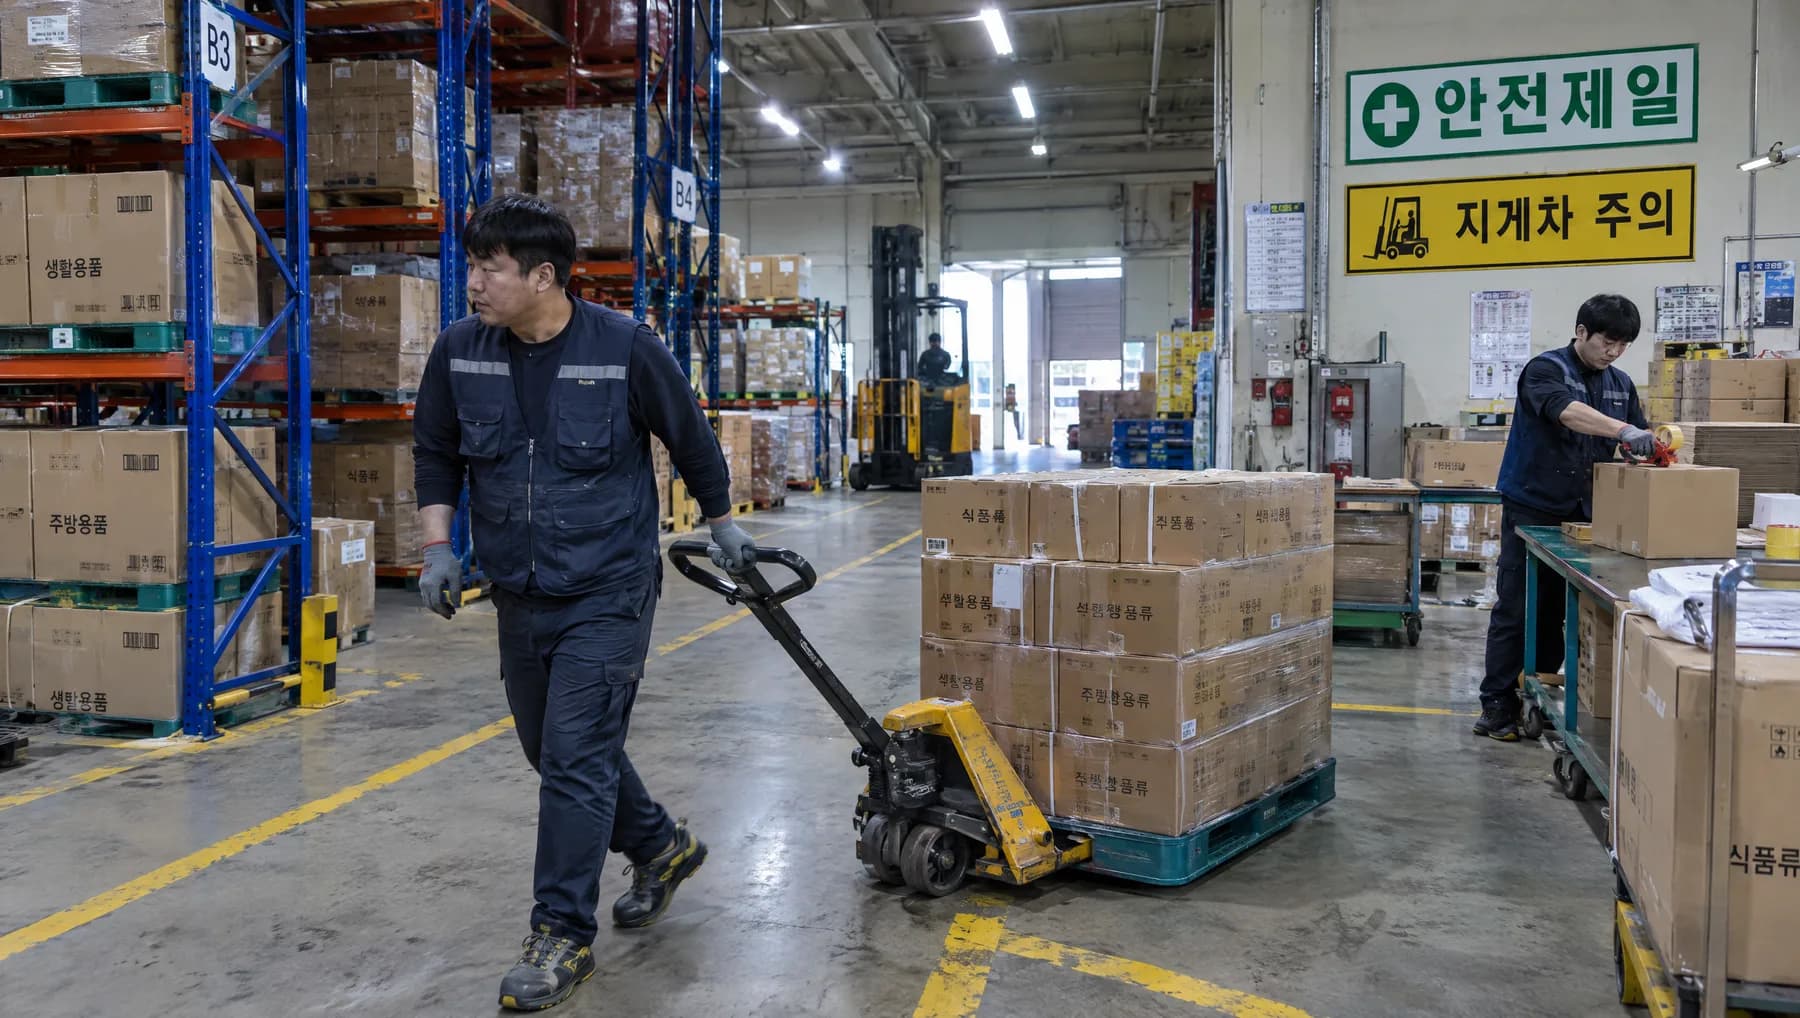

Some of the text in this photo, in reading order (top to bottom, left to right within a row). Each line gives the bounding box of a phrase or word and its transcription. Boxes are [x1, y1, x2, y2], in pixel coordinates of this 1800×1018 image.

[208, 22, 231, 72] B3
[1435, 62, 1679, 140] 안전제일
[676, 180, 692, 210] B4
[1456, 189, 1674, 243] 지게차 주의
[45, 257, 103, 279] 생활용품
[49, 514, 108, 535] 주방용품
[1729, 844, 1800, 878] 식품류
